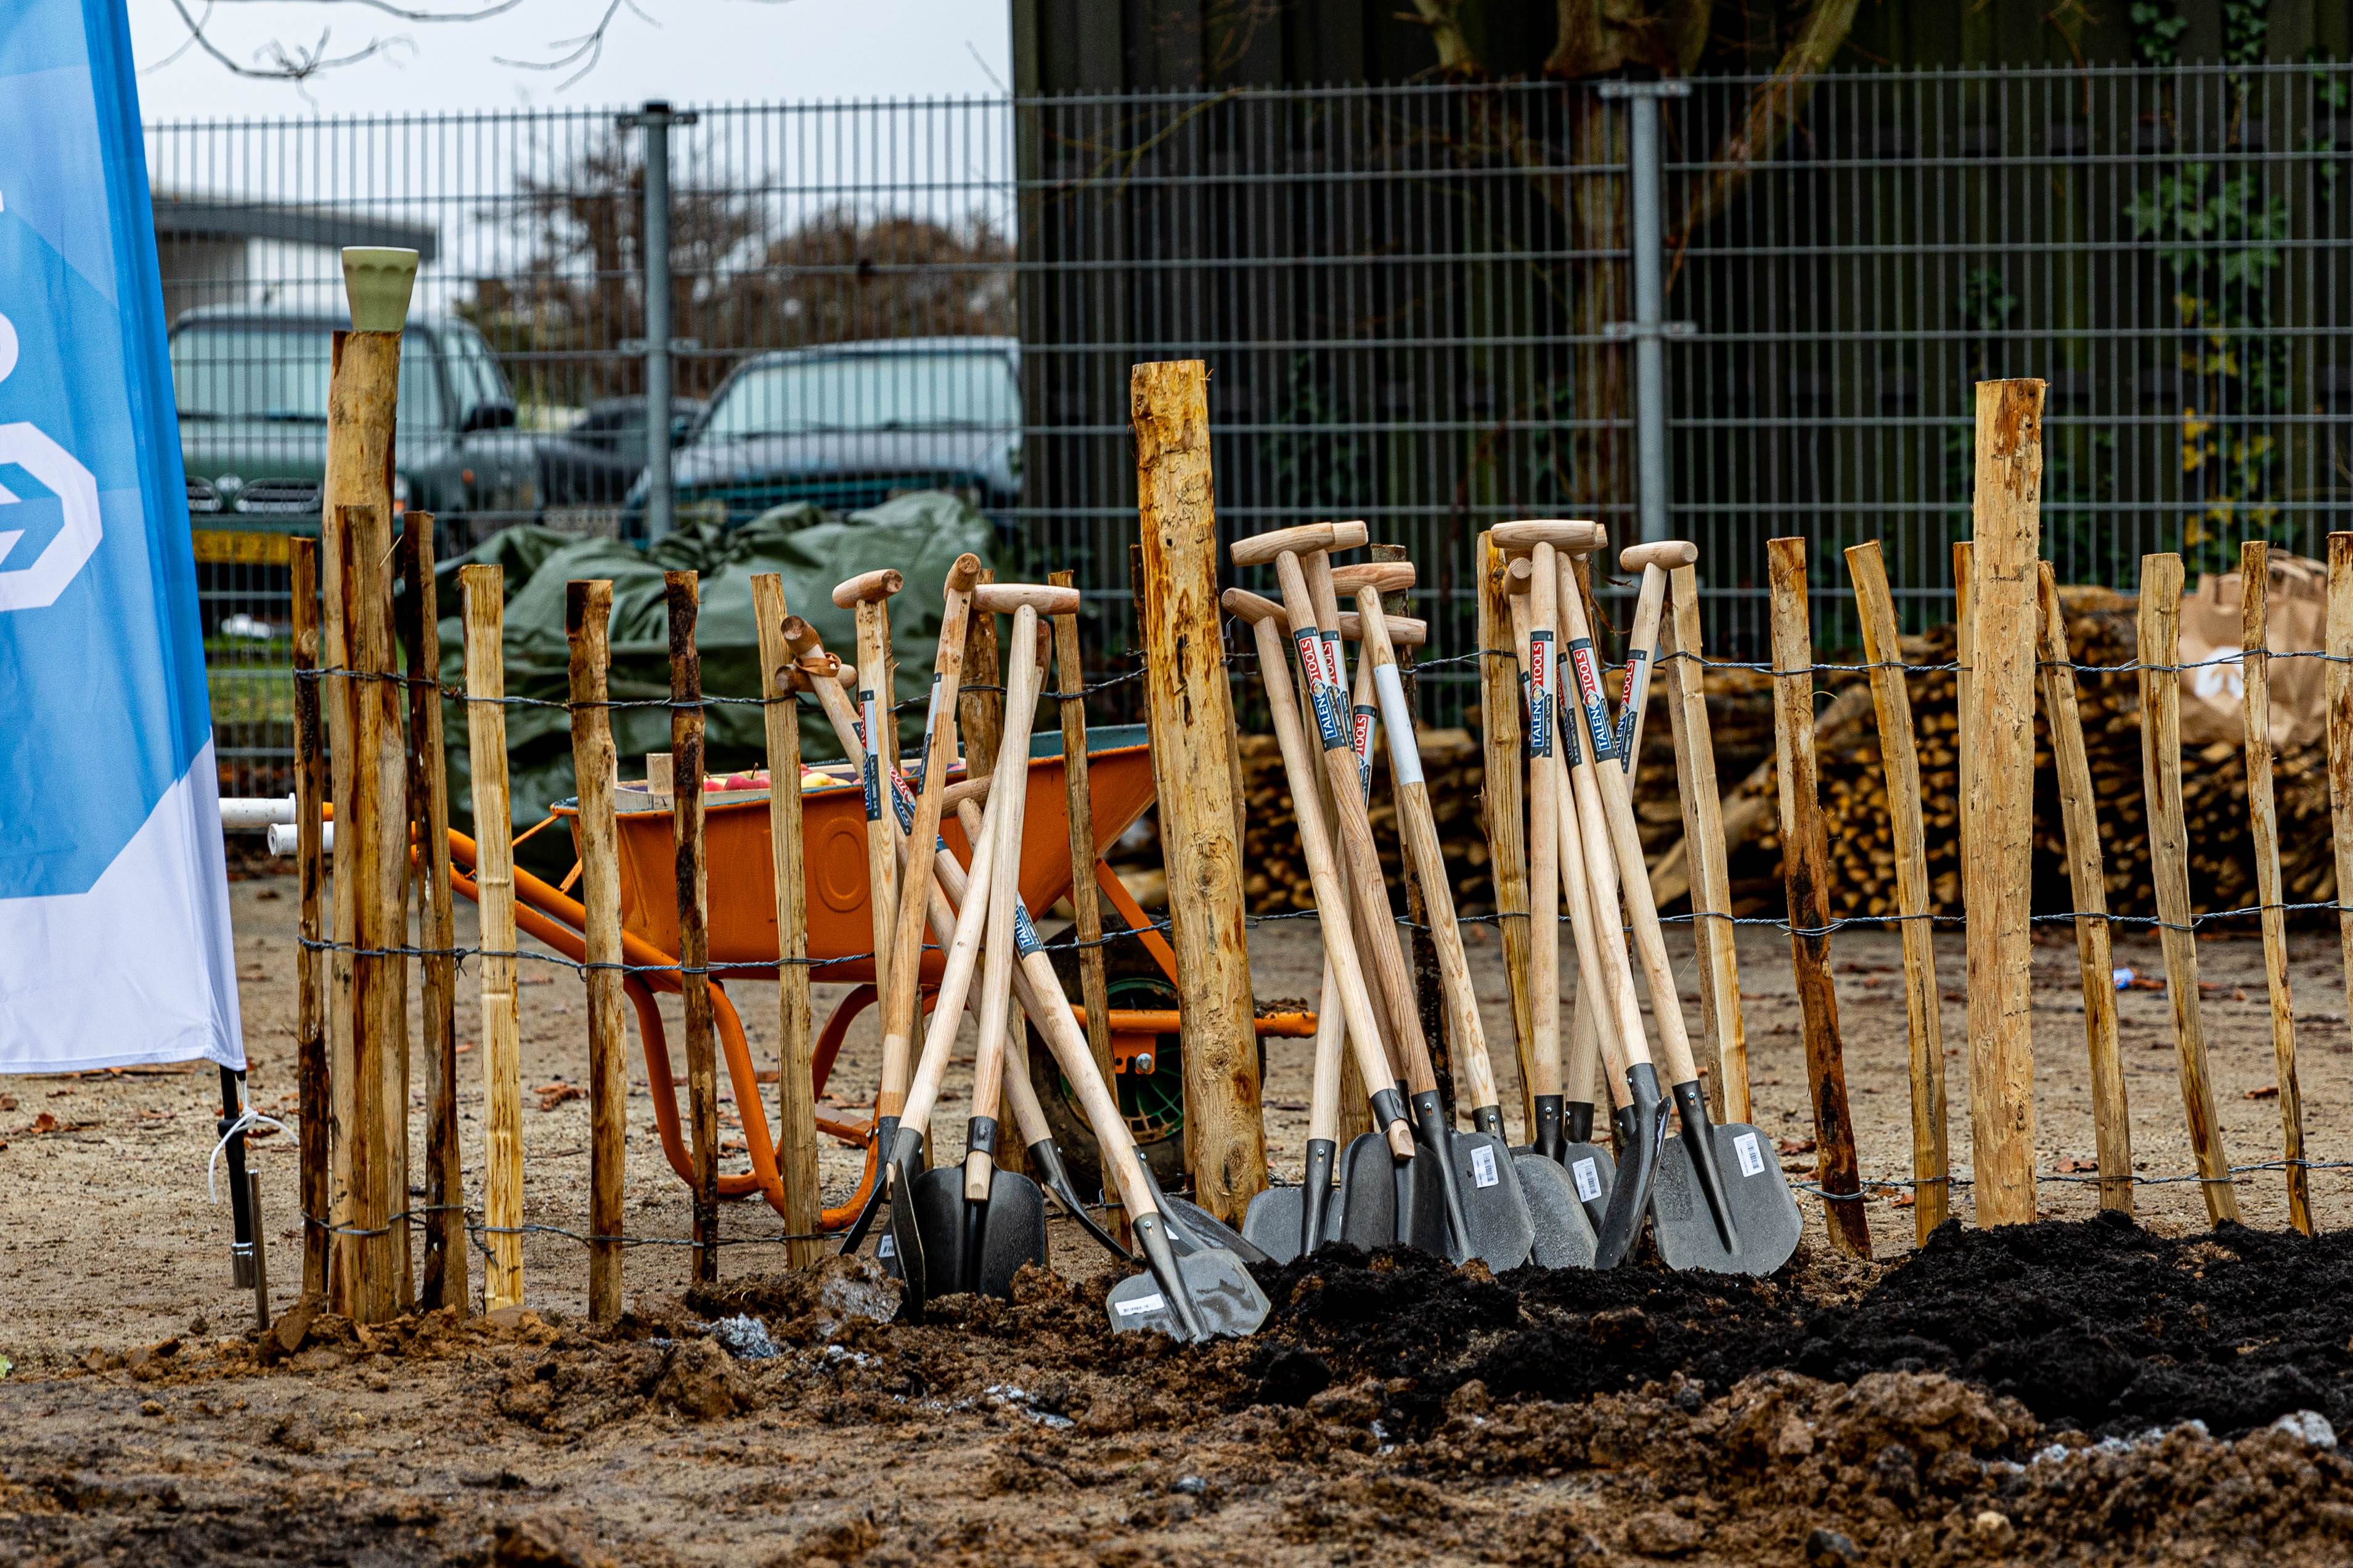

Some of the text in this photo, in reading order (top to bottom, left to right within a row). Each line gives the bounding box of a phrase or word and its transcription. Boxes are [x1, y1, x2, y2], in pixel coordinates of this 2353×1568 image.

[1302, 640, 1334, 738] TALEN TOOLS
[1533, 644, 1543, 745] TALEN TOOLS
[1576, 651, 1607, 750] TALEN TOOLS
[1622, 662, 1634, 702] TOOLS
